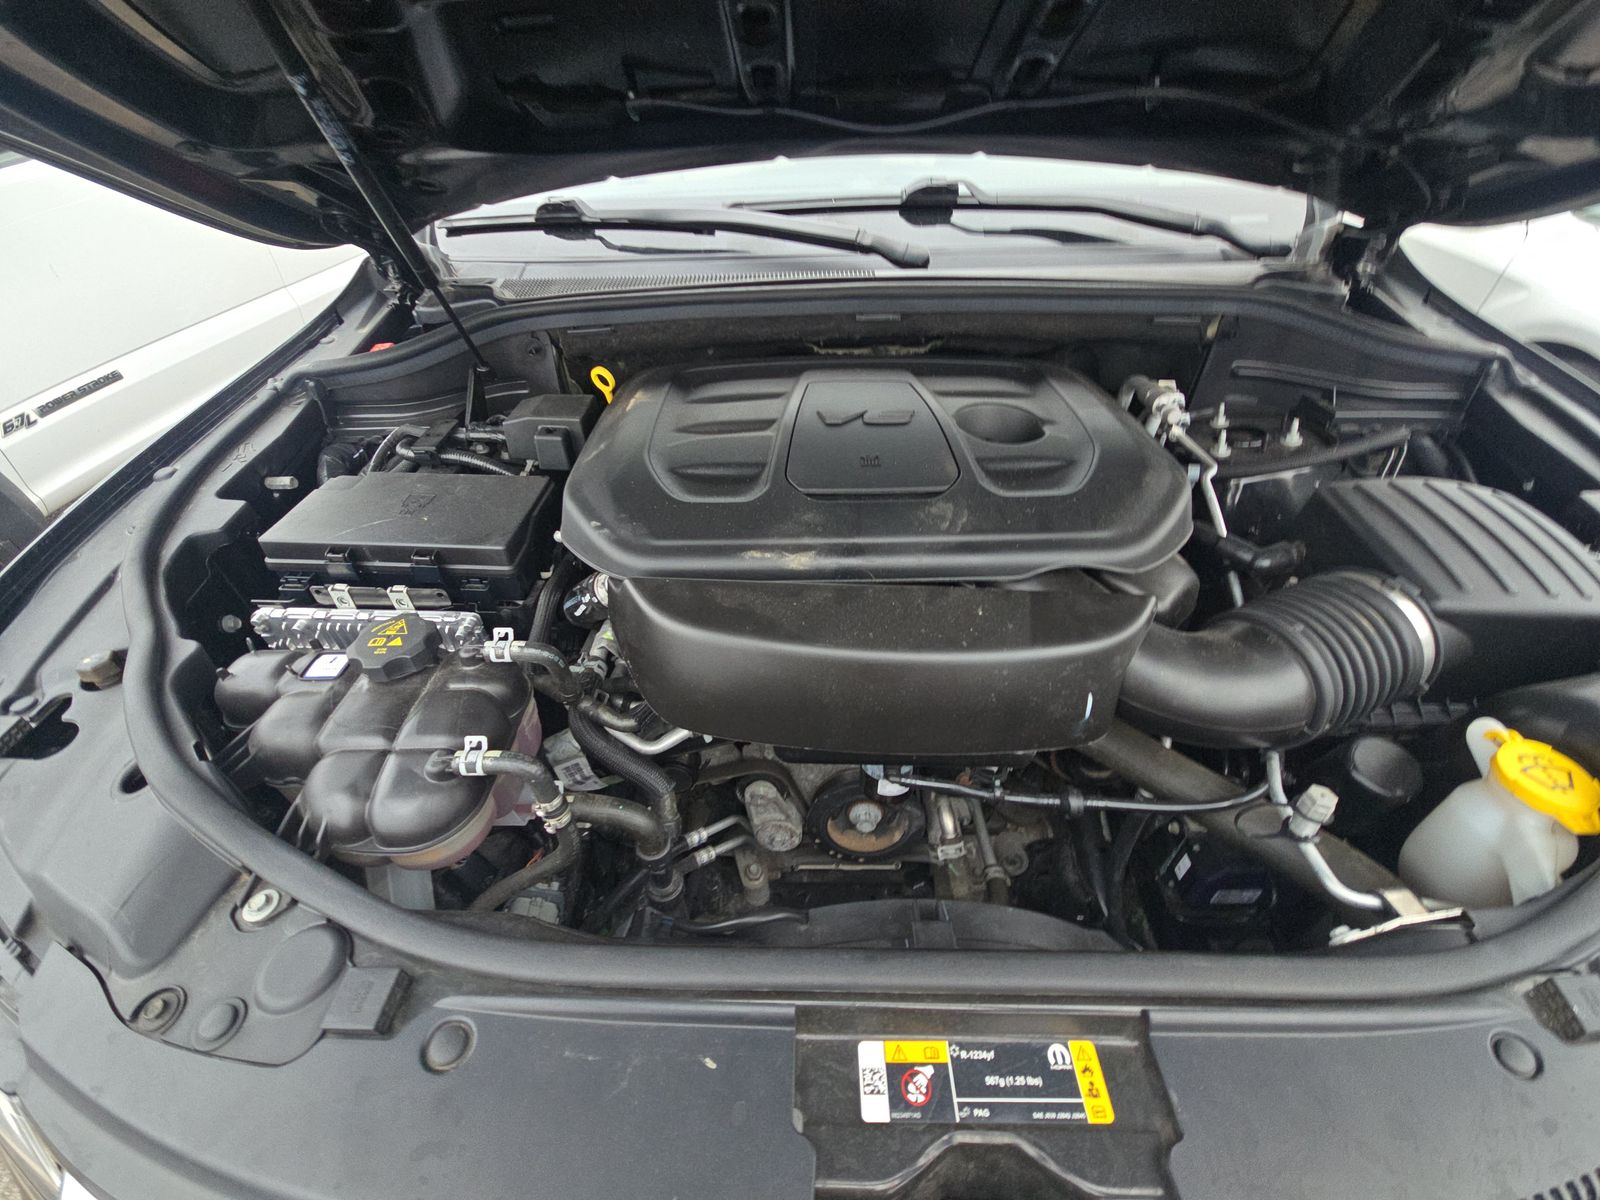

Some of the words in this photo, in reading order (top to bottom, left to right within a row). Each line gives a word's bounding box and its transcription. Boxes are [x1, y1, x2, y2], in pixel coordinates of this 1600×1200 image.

[37, 390, 77, 413] POWER
[77, 369, 119, 394] STROKE
[960, 1049, 995, 1061] R-1234yf
[973, 1108, 990, 1118] PAG
